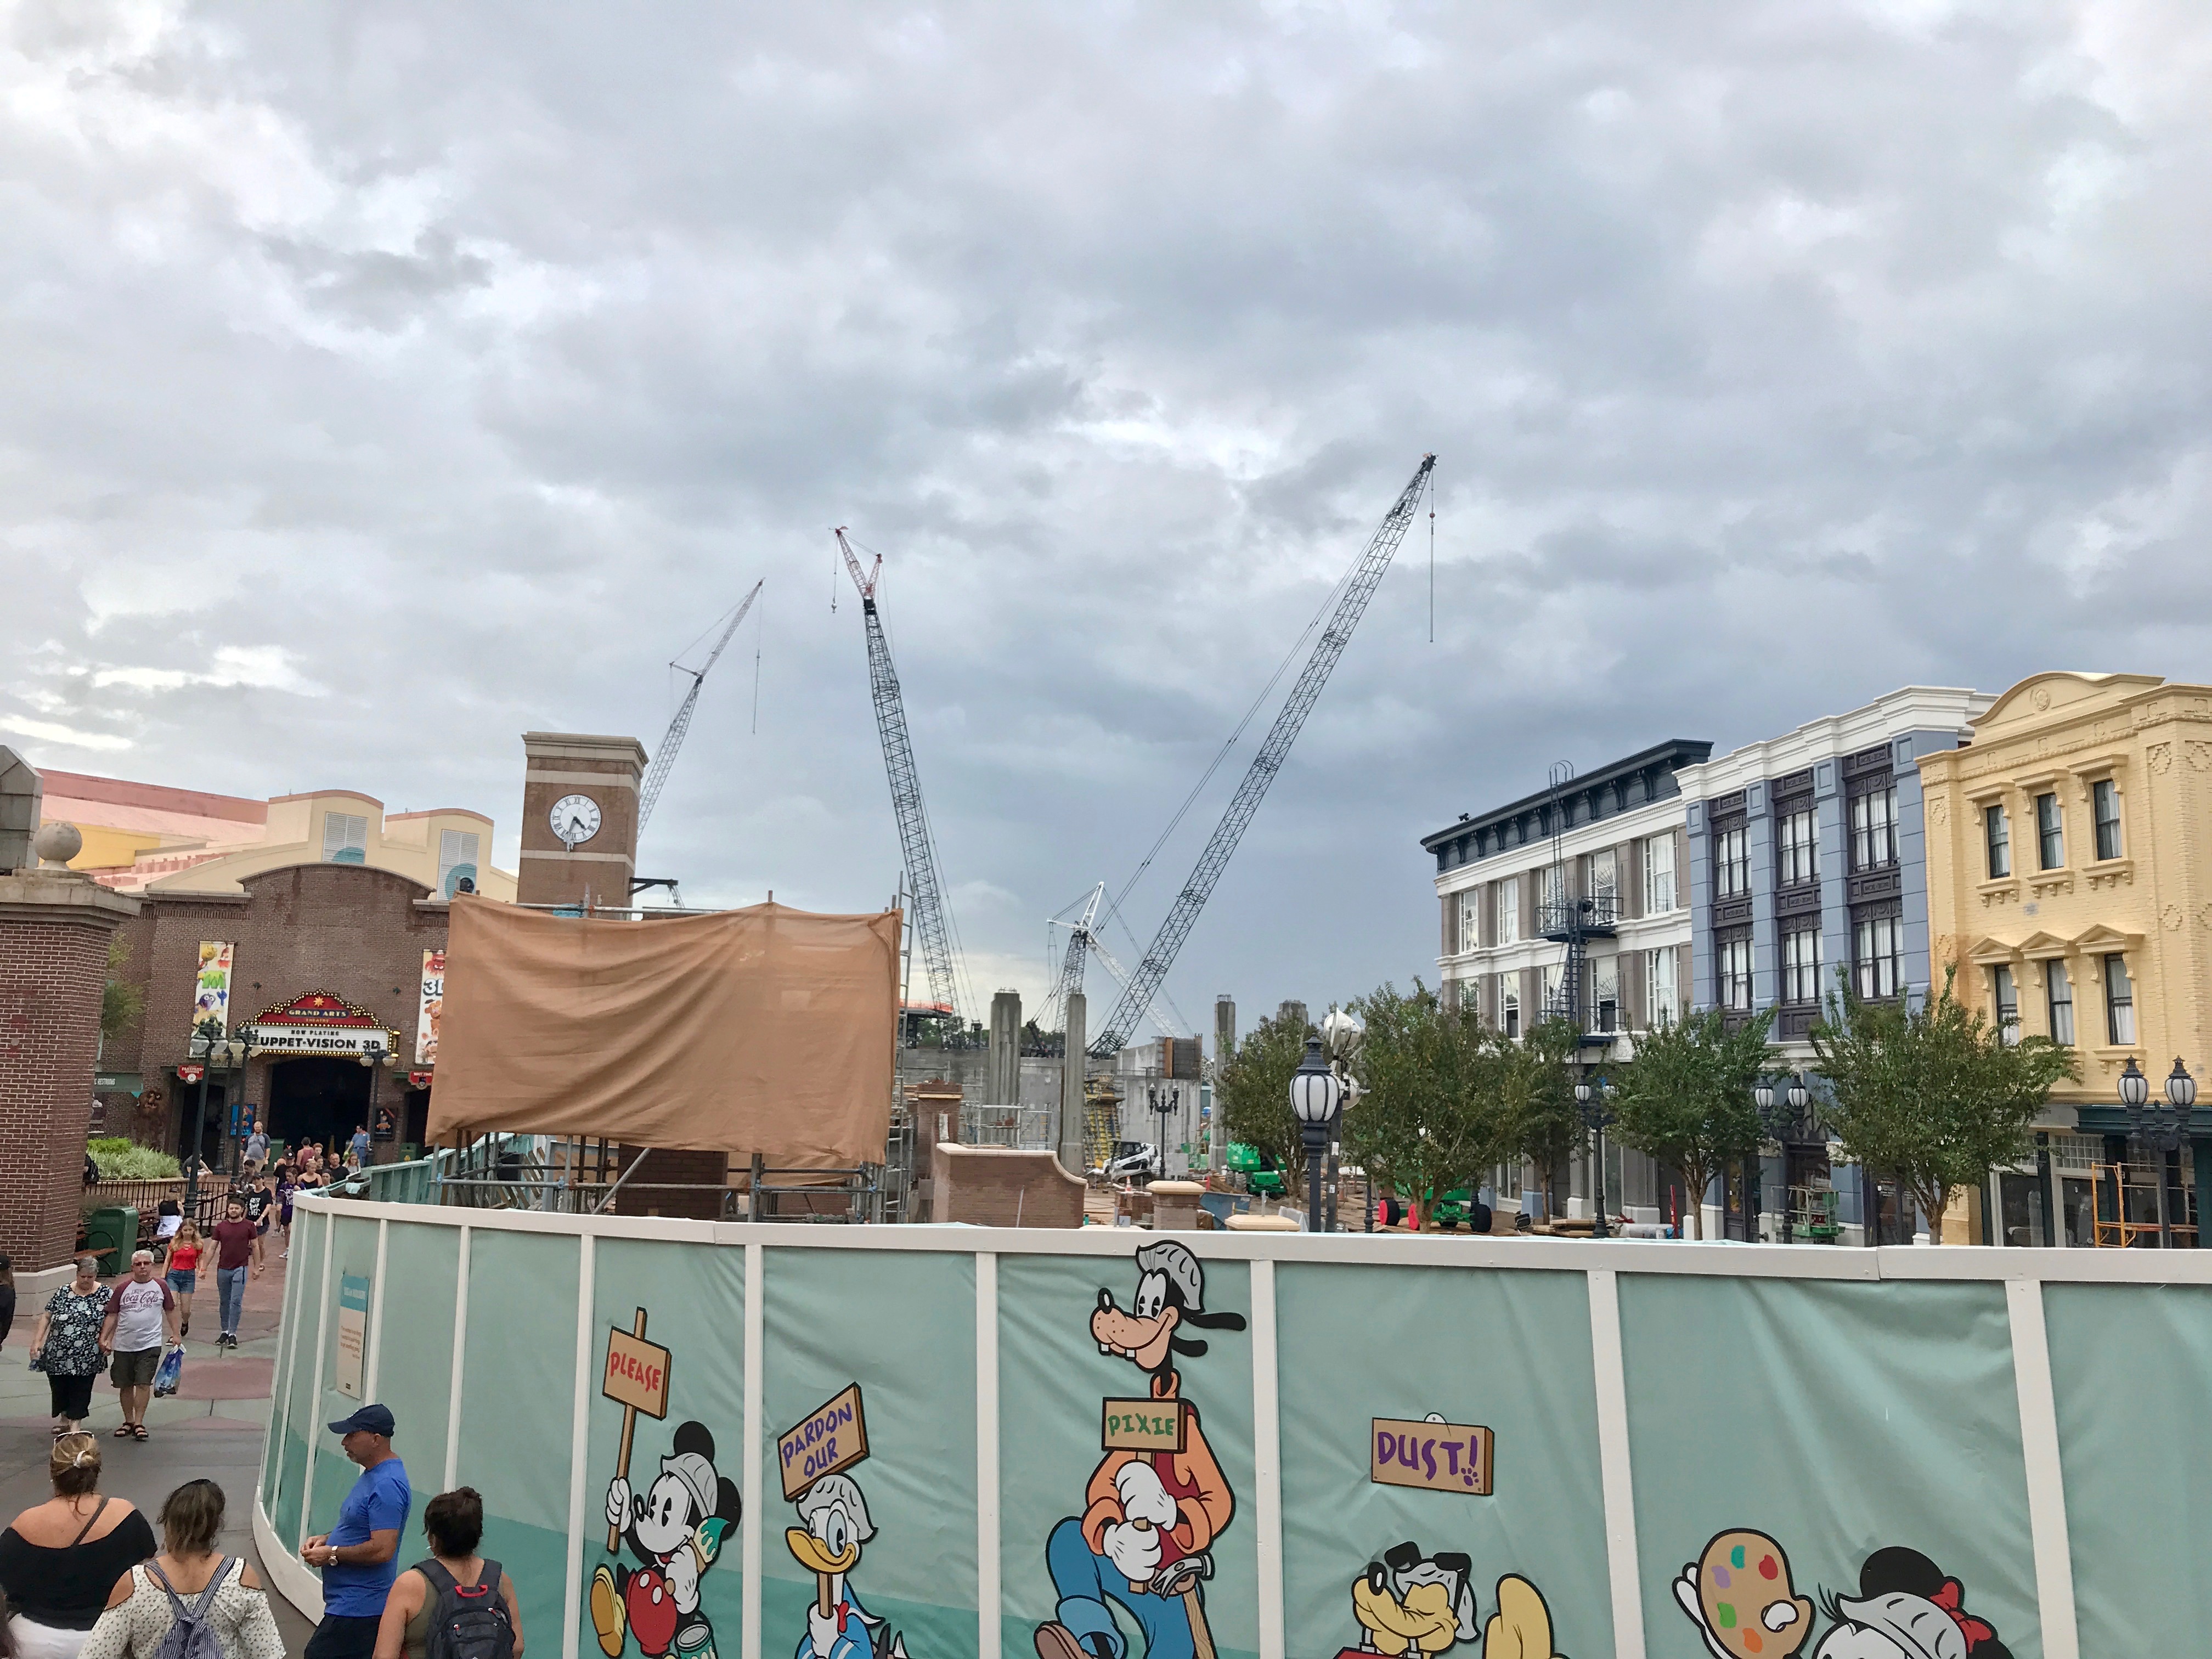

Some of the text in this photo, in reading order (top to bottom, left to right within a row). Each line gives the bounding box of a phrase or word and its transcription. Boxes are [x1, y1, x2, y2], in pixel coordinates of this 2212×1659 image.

[363, 1040, 380, 1049] 3D
[610, 1352, 662, 1393] PLEASE
[782, 1402, 852, 1469] PARDON
[1108, 1413, 1175, 1437] PIXIE
[804, 1437, 838, 1478] OUR
[1378, 1431, 1479, 1486] DUST!
